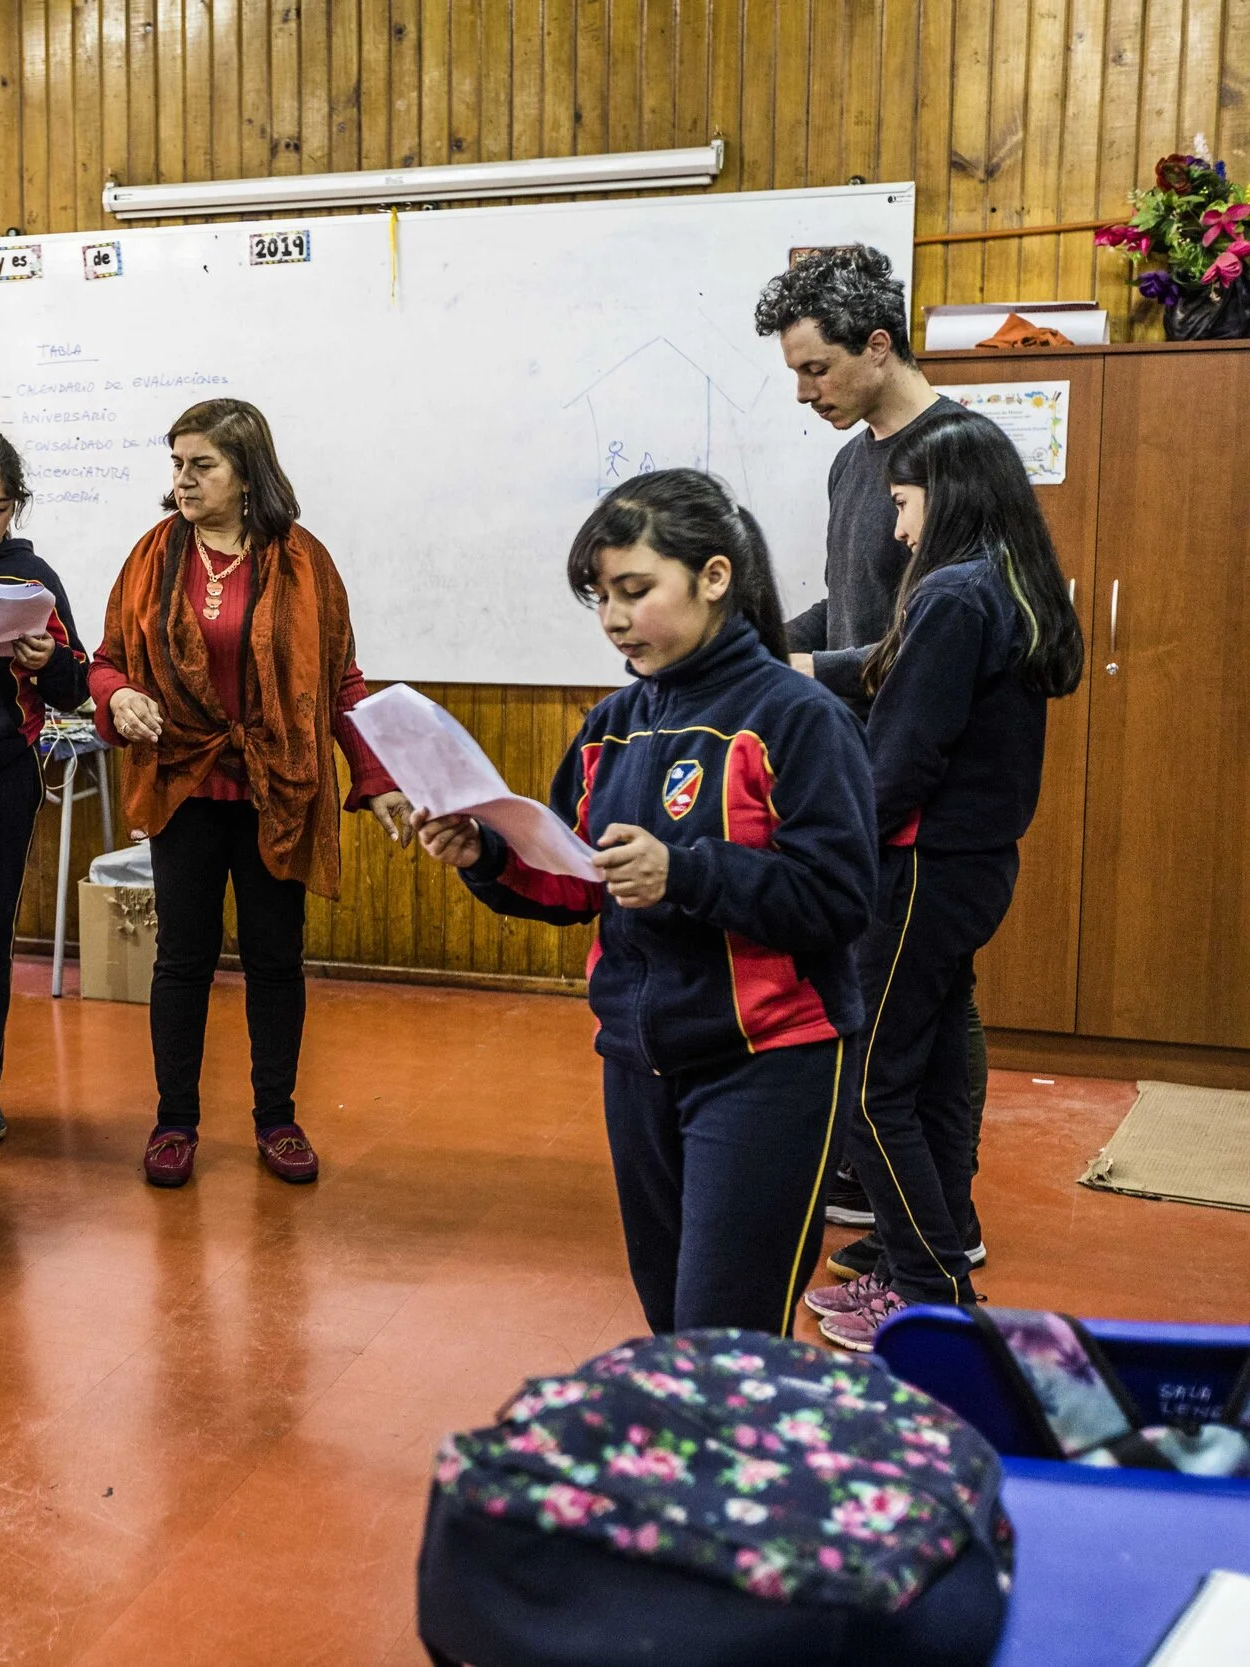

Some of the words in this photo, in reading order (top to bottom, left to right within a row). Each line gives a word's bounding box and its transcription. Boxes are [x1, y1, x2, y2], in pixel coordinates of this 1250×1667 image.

[12, 255, 27, 267] es
[93, 250, 111, 266] de
[255, 235, 304, 259] 2019
[36, 342, 81, 358] TABLA
